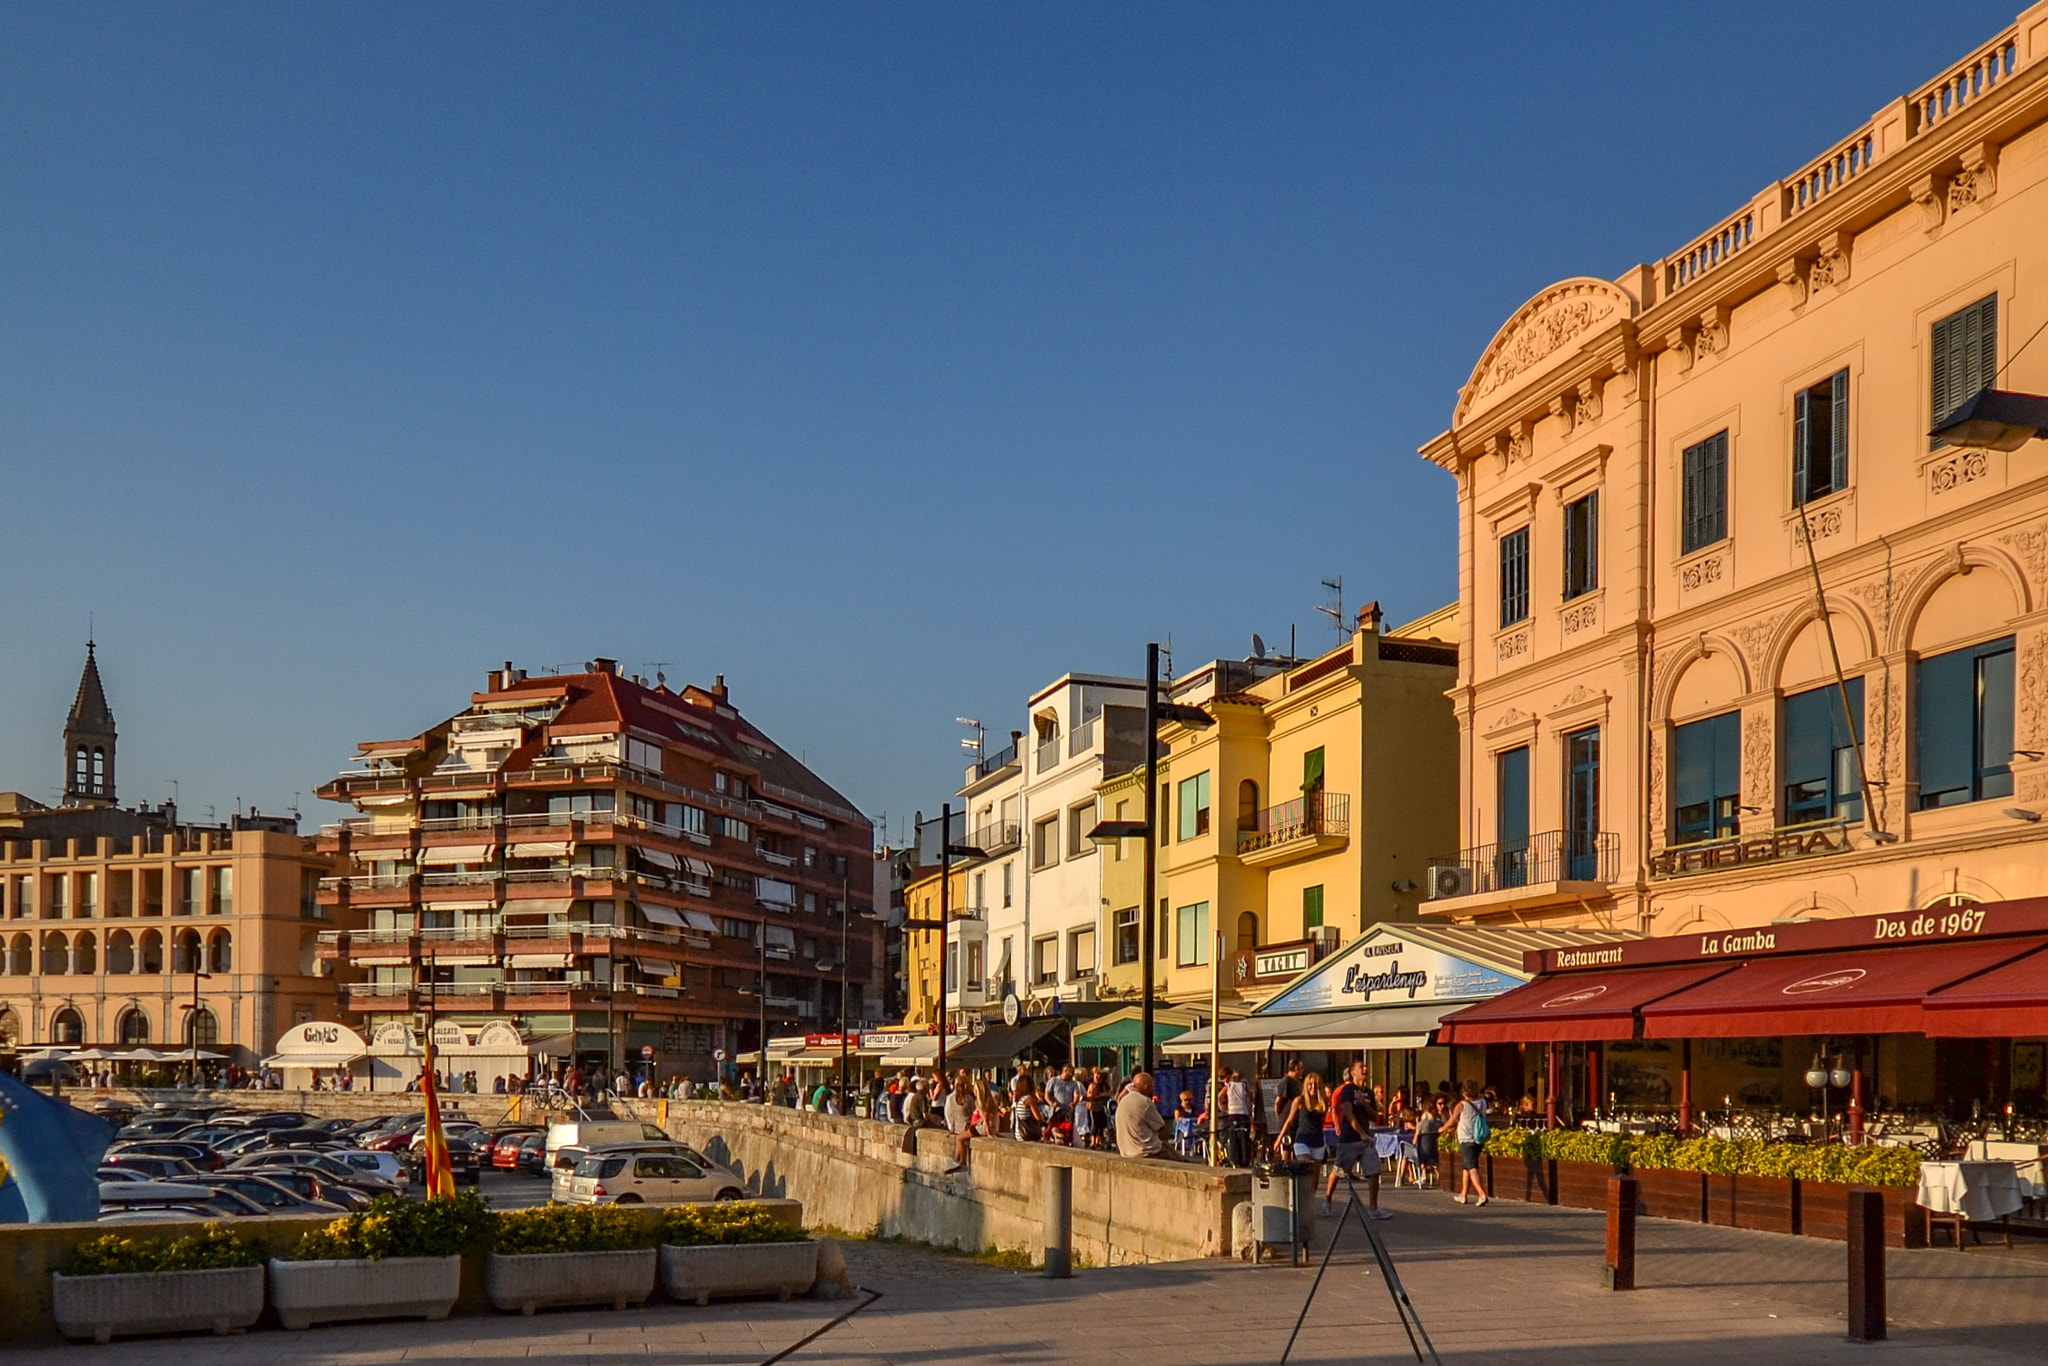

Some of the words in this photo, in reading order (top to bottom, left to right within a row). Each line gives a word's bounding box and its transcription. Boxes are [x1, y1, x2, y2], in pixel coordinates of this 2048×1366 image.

[1677, 830, 1839, 872] RIBERA
[1556, 946, 1624, 968] Restaurant
[1701, 936, 1719, 955] La
[1722, 931, 1776, 954] Gamba
[1874, 918, 1906, 940] Des
[1911, 914, 1935, 936] de
[1940, 909, 1986, 935] 1967
[1341, 960, 1428, 1002] L'espardenya
